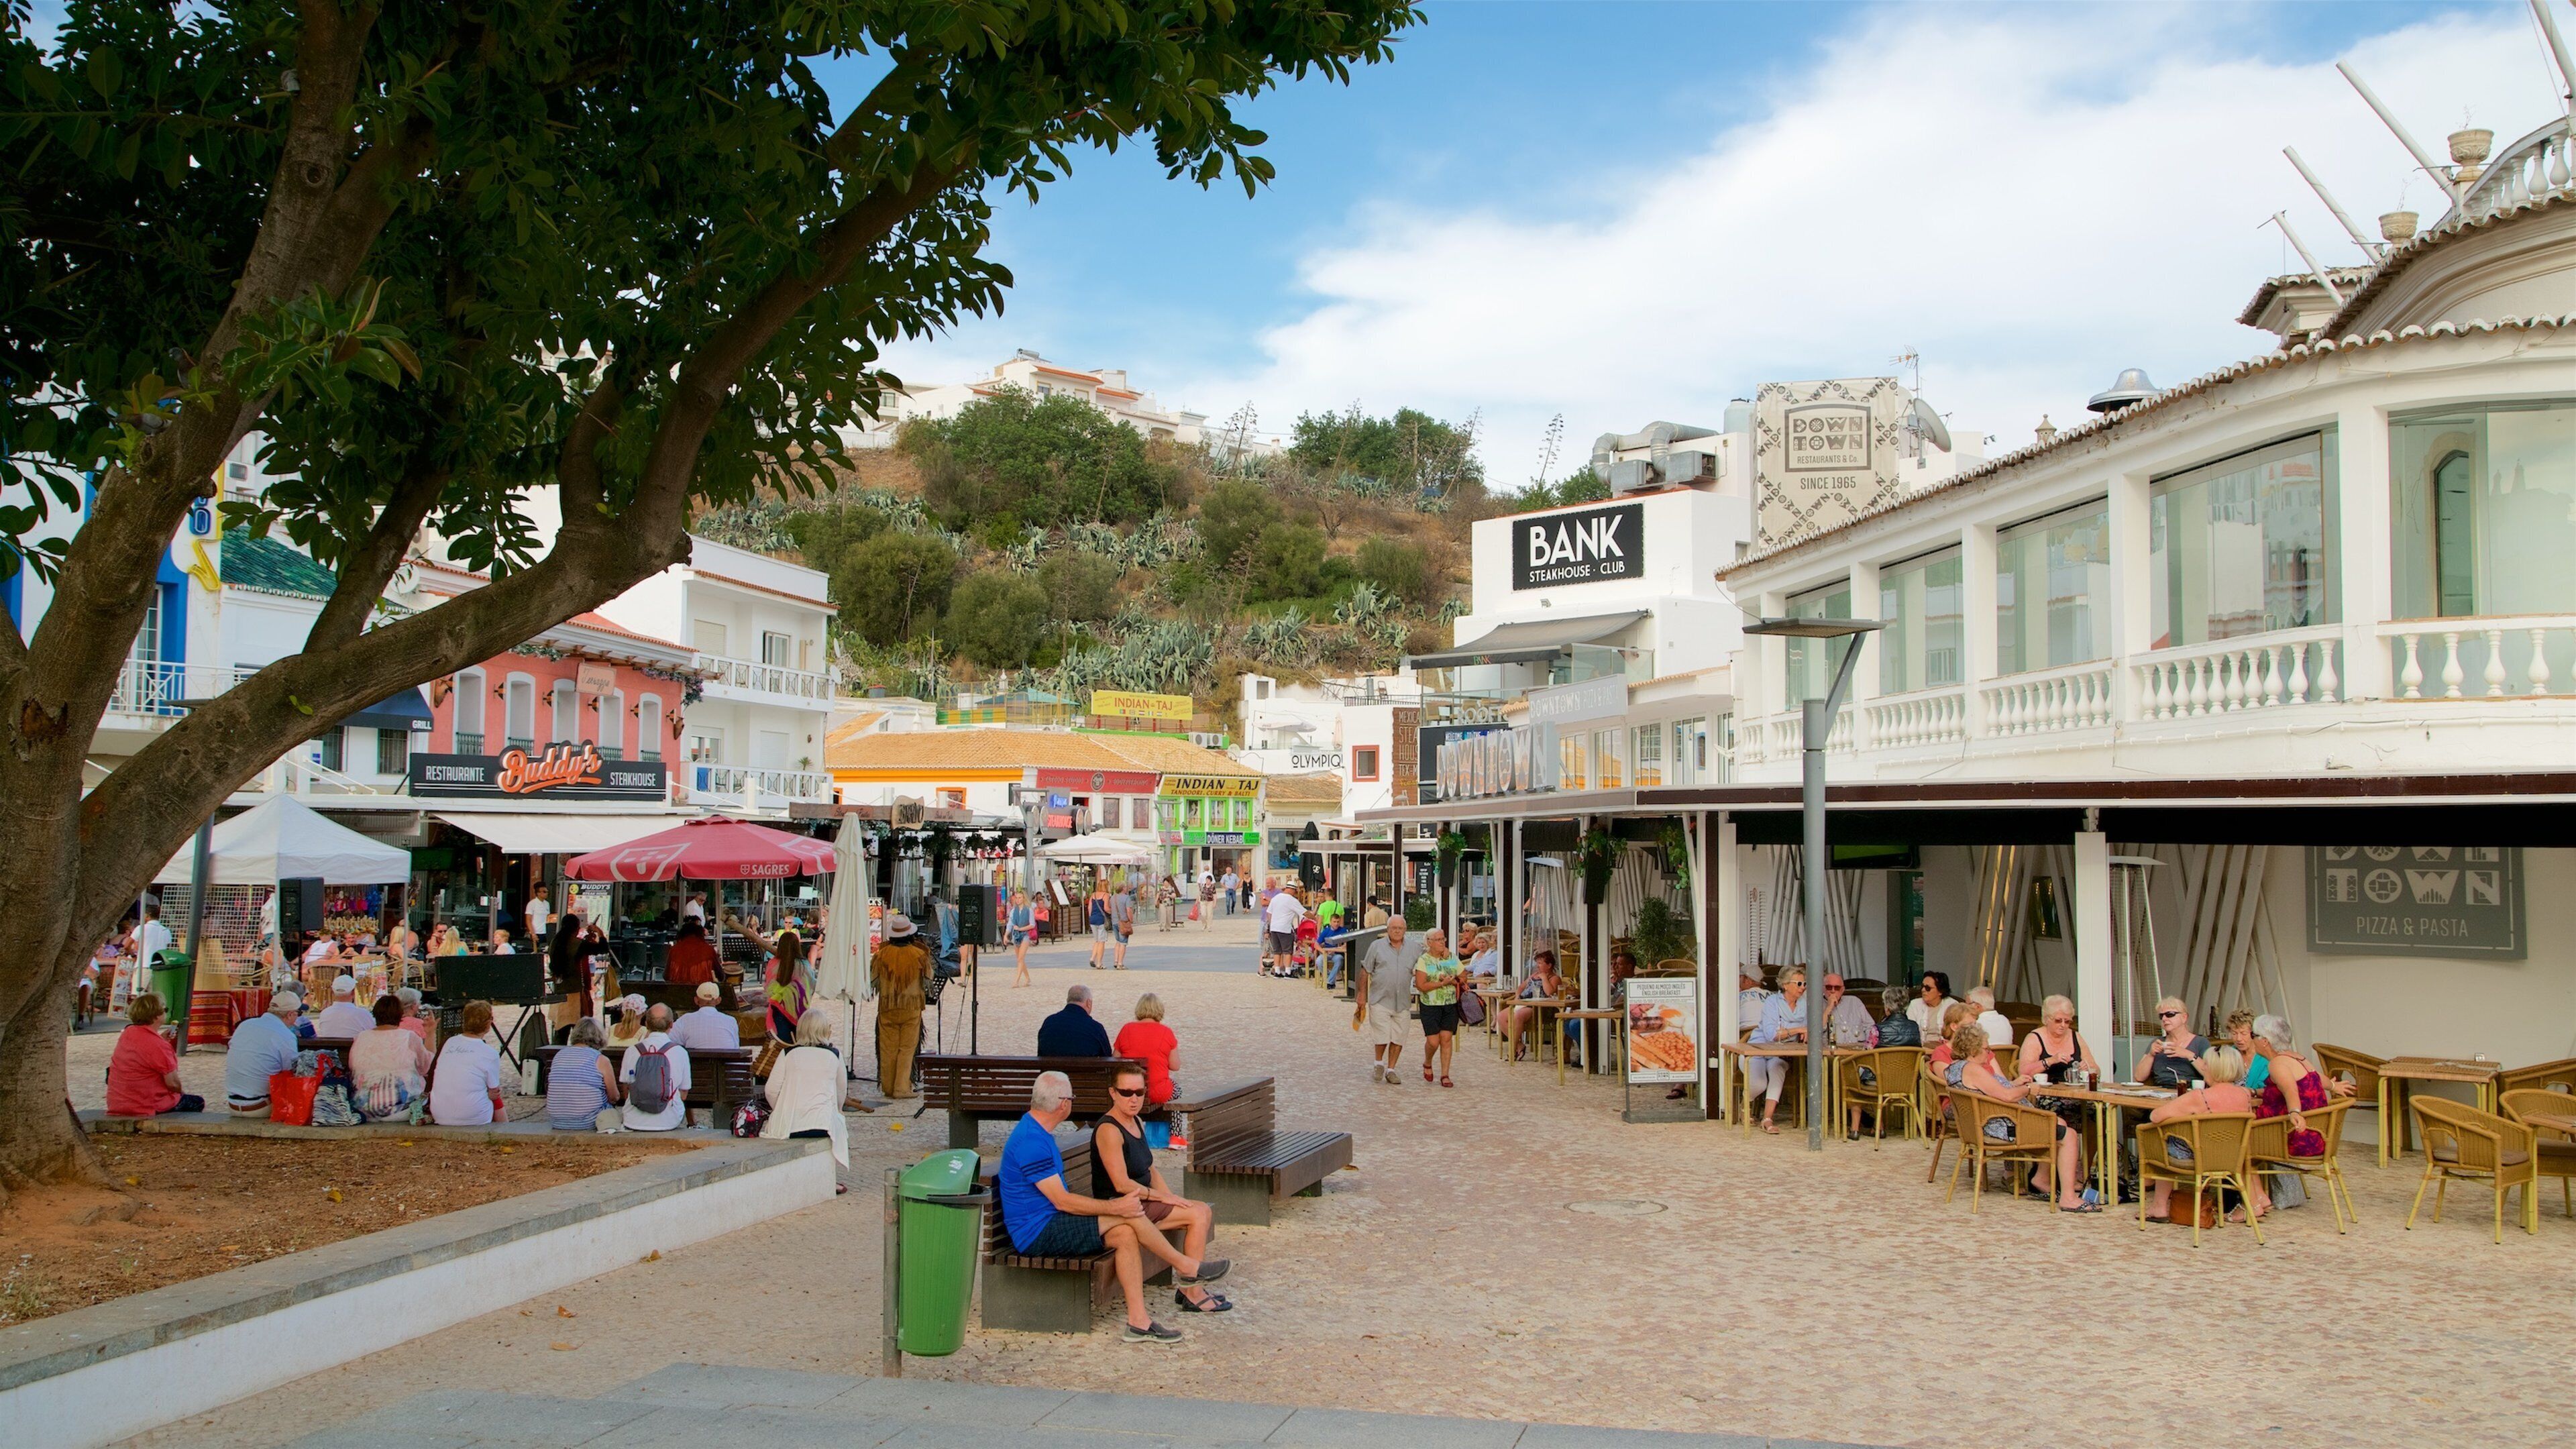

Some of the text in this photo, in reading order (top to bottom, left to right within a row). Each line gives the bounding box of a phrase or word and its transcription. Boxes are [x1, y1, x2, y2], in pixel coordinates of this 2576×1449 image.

[1793, 417, 1862, 433] DOWN
[1793, 435, 1862, 451] TOWN
[1797, 455, 1841, 464] RESTAURANTS
[1801, 476, 1856, 490] SINCE 1965
[1529, 515, 1624, 567] BANK
[1529, 561, 1625, 582] STEAKHOUSE CLUB
[1114, 697, 1149, 708] INDIAN
[1157, 700, 1173, 710] TAJ
[412, 720, 432, 729] GRILL
[425, 765, 484, 782] RESTAURANTE
[497, 745, 602, 794] Buddy's
[610, 772, 655, 787] STEAKHOUSE
[1176, 778, 1258, 790] INDIAN TAJ
[1208, 833, 1224, 843] DÖNER
[1226, 834, 1242, 843] KEBAB
[751, 864, 790, 875] SAGRES
[2326, 868, 2500, 906] TOWN
[2357, 916, 2468, 937] PIZZA & PASTA
